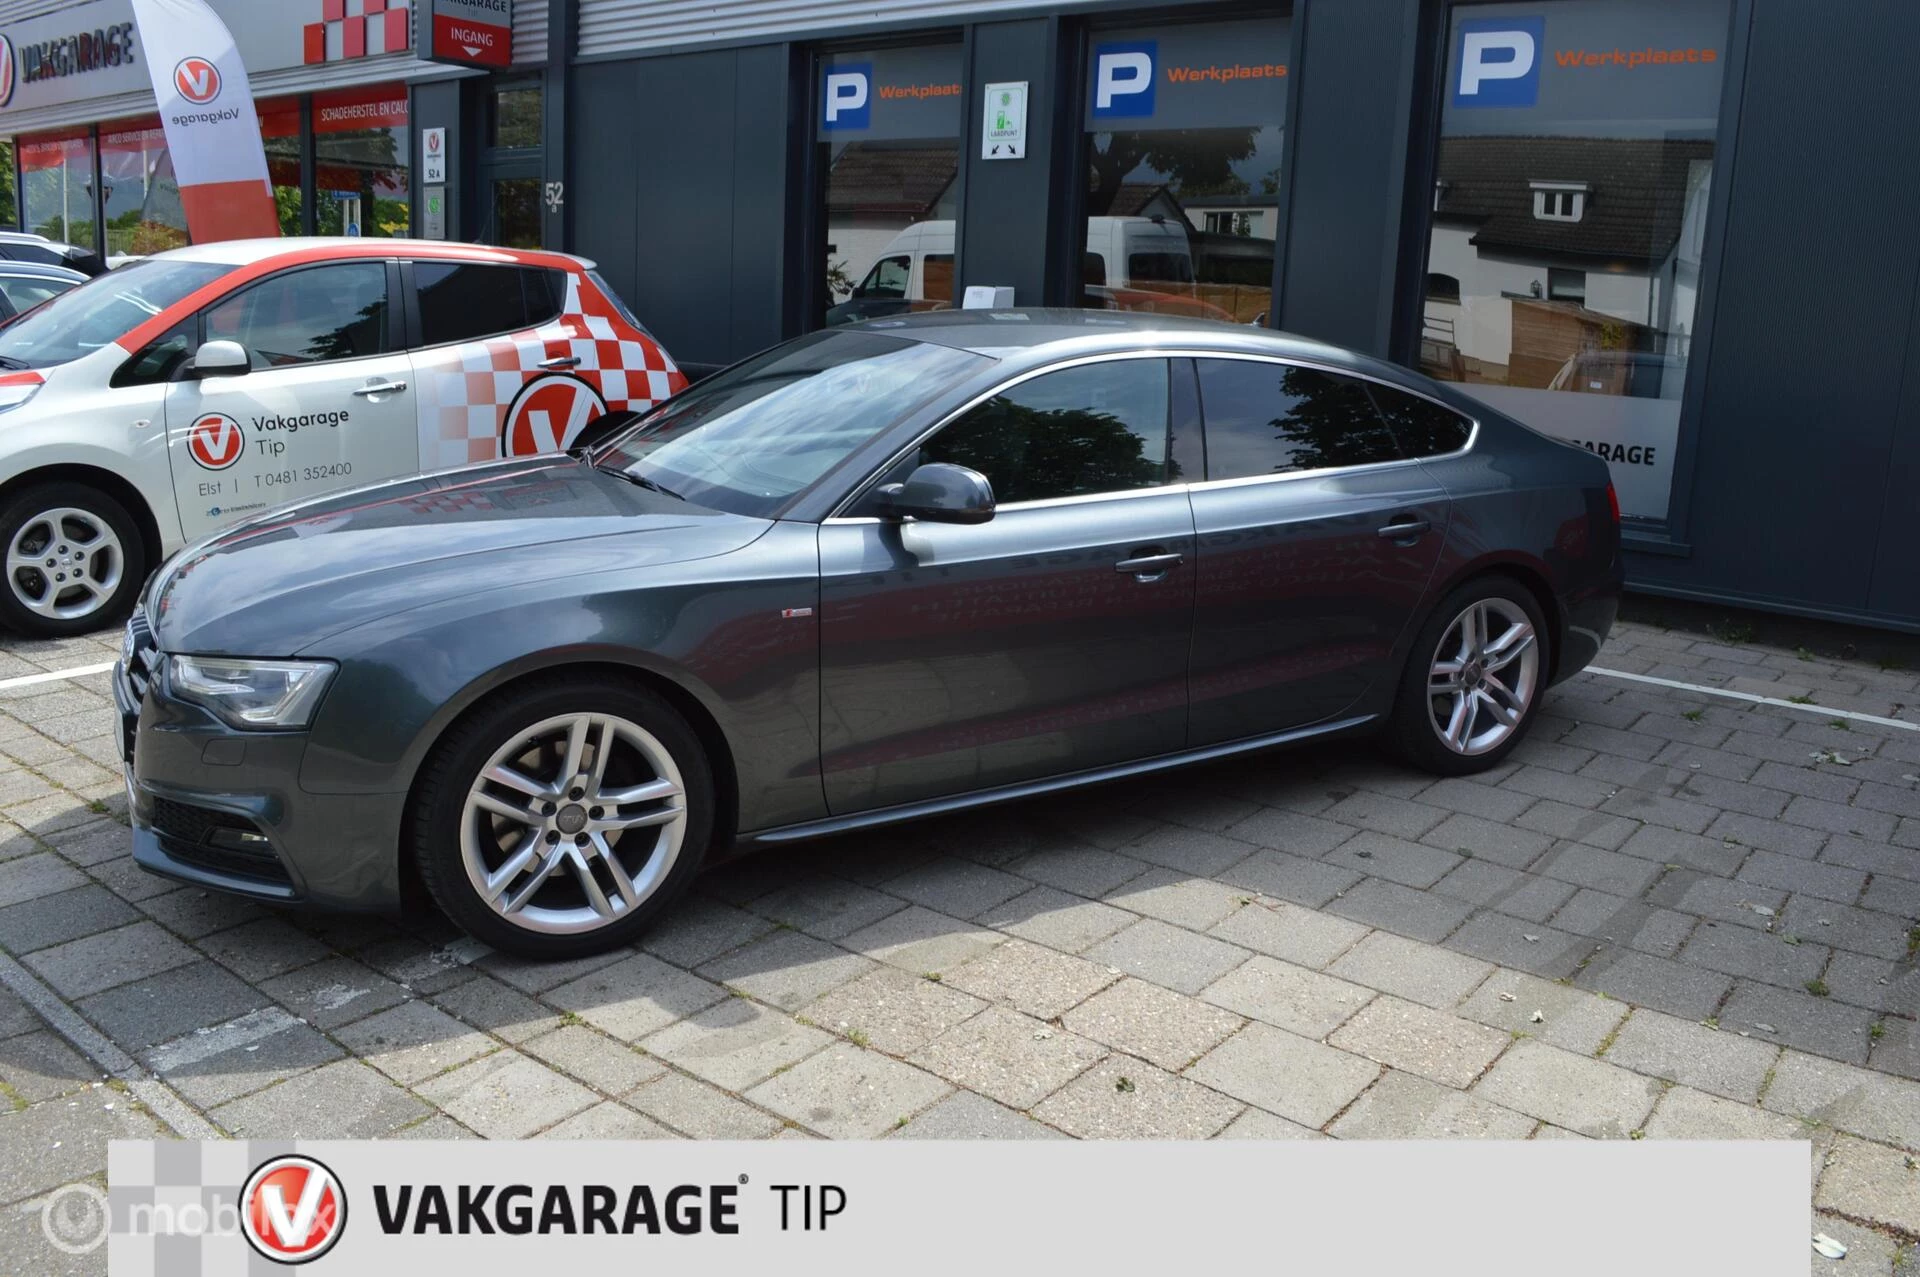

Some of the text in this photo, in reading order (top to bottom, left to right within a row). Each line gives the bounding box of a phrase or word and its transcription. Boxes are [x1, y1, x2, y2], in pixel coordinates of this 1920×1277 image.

[451, 27, 493, 46] INGANG
[19, 22, 133, 83] VAKGARAGE
[1555, 47, 1717, 70] Werkplaats
[1167, 63, 1288, 84] Werkplaats
[879, 83, 962, 100] Werkplaat
[321, 103, 377, 122] SCHADEHERSTEL
[379, 103, 389, 116] EN
[428, 168, 440, 178] 52 A
[545, 182, 564, 205] 52
[551, 204, 558, 213] a
[252, 410, 350, 433] Vakgarage
[256, 439, 286, 457] Tip
[199, 482, 222, 496] Elst
[254, 475, 261, 488] T
[265, 469, 298, 487] 0481
[303, 461, 352, 480] 352400
